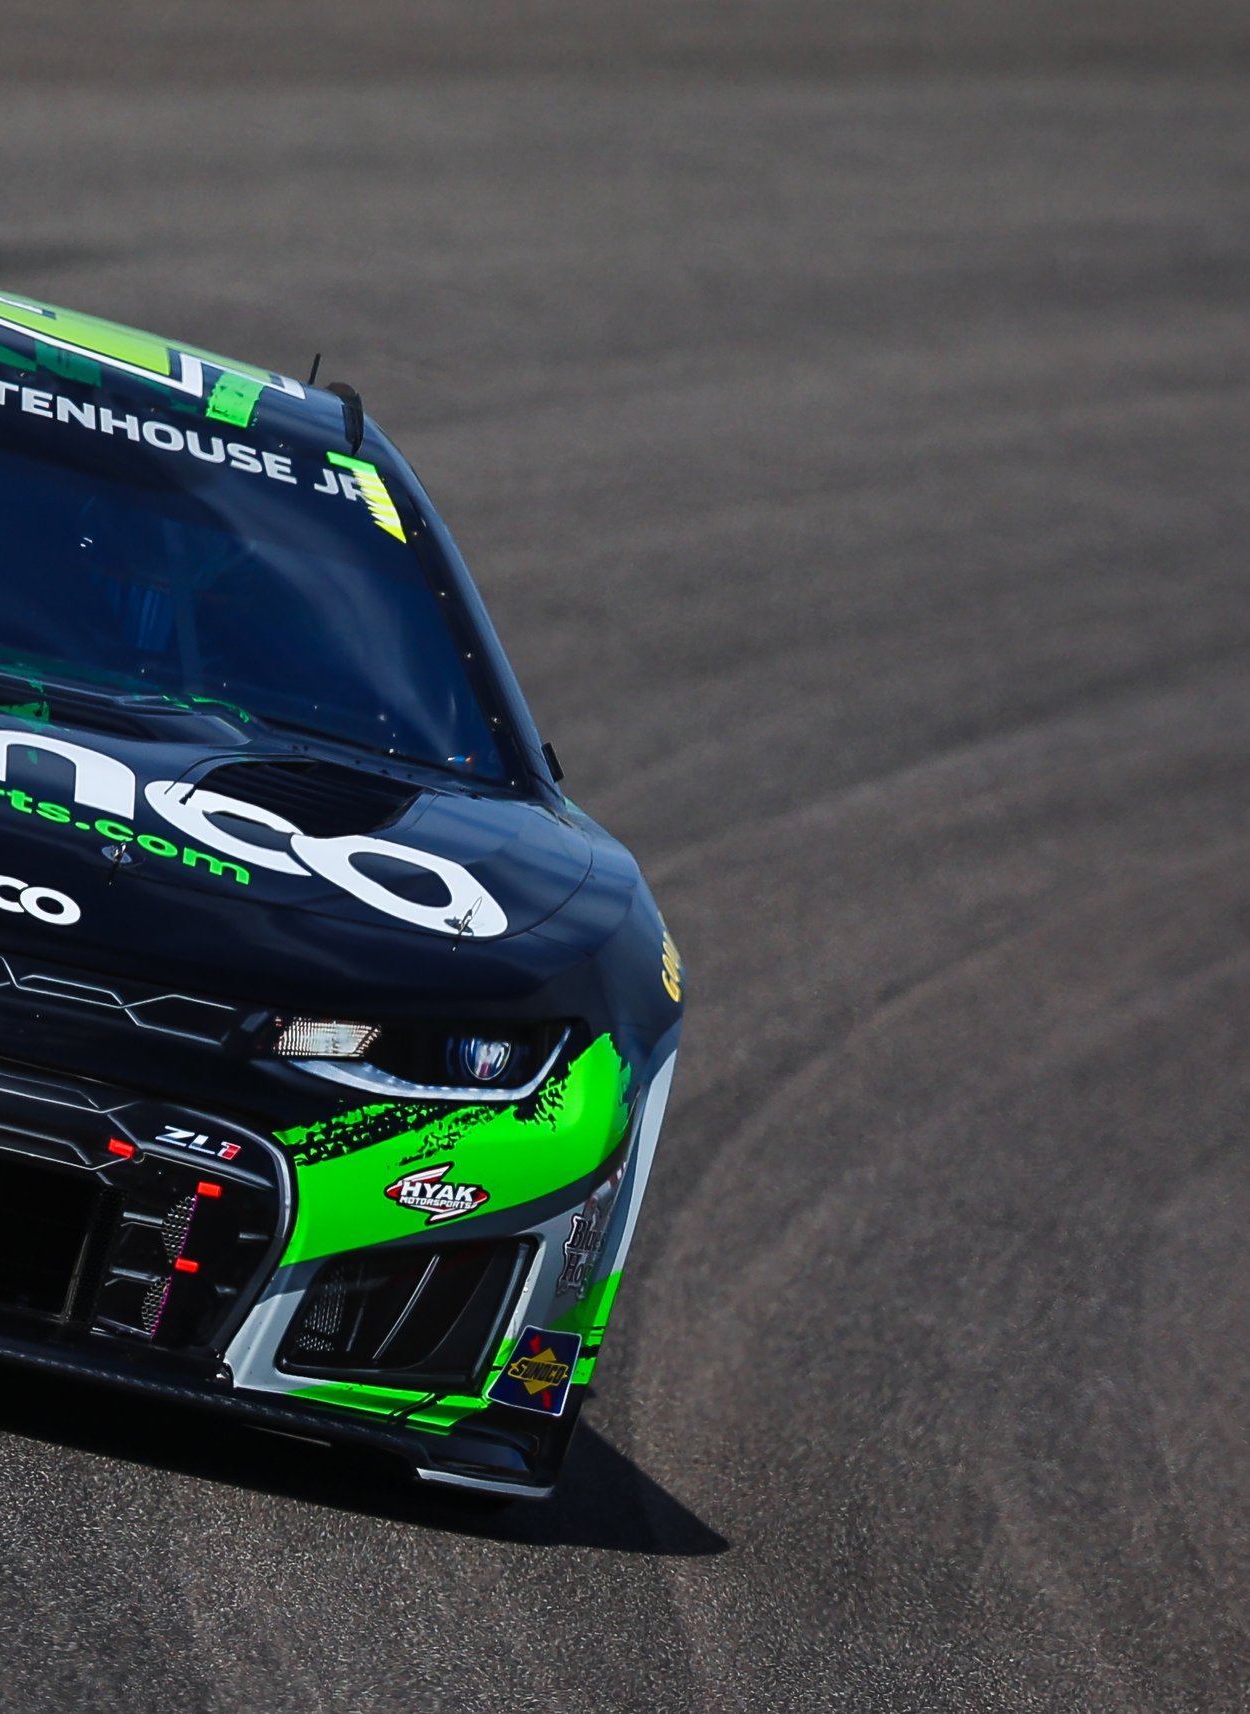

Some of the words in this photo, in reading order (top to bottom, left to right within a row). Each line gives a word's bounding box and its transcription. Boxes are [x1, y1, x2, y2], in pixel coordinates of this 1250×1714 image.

[155, 1125, 241, 1160] ZL1
[400, 1181, 477, 1202] HYAK
[399, 1197, 472, 1210] MOTORSPORTS
